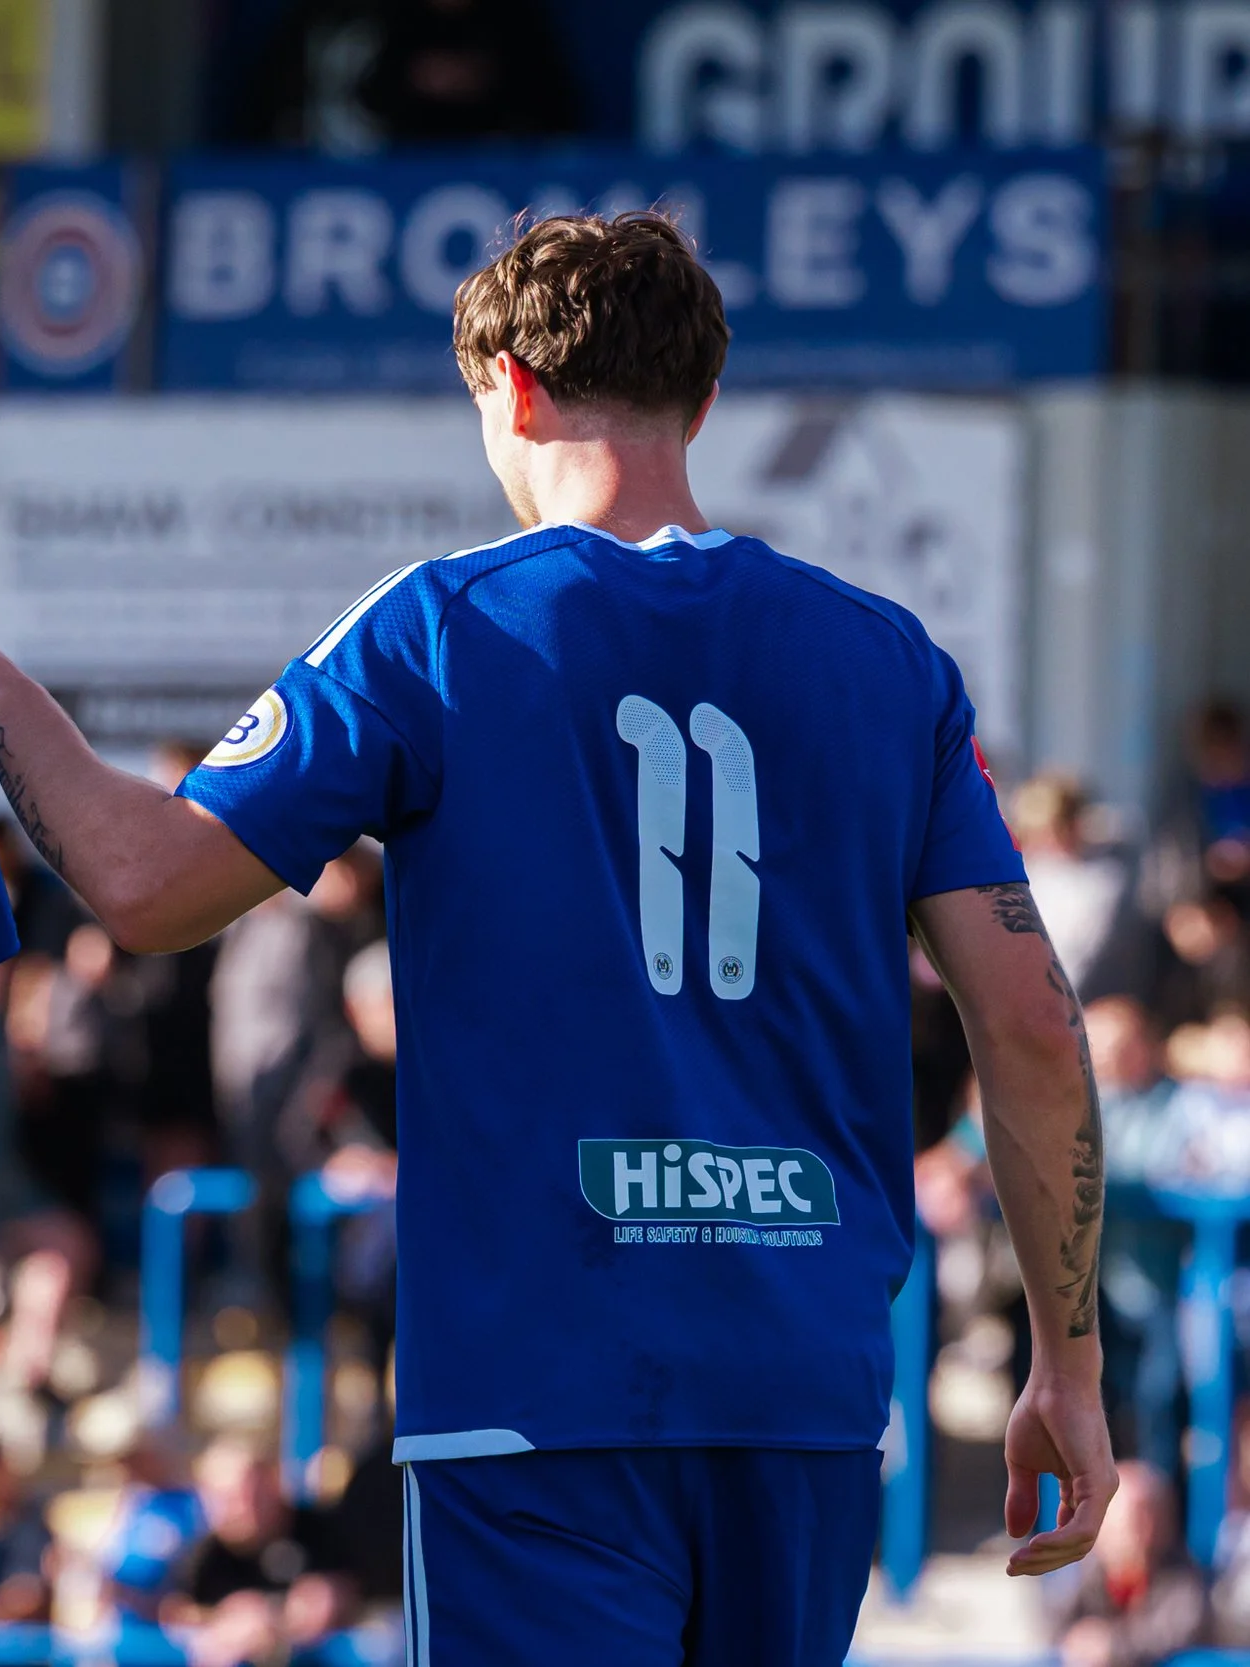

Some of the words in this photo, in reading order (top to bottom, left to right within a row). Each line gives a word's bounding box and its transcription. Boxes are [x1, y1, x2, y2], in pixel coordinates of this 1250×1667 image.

[616, 694, 760, 1000] 11
[613, 1143, 812, 1216] HiSPEC
[614, 1226, 643, 1243] LIFE
[646, 1226, 698, 1243] SAFETY
[715, 1227, 760, 1245] HOUSING
[761, 1230, 823, 1247] SOLUTIONS
